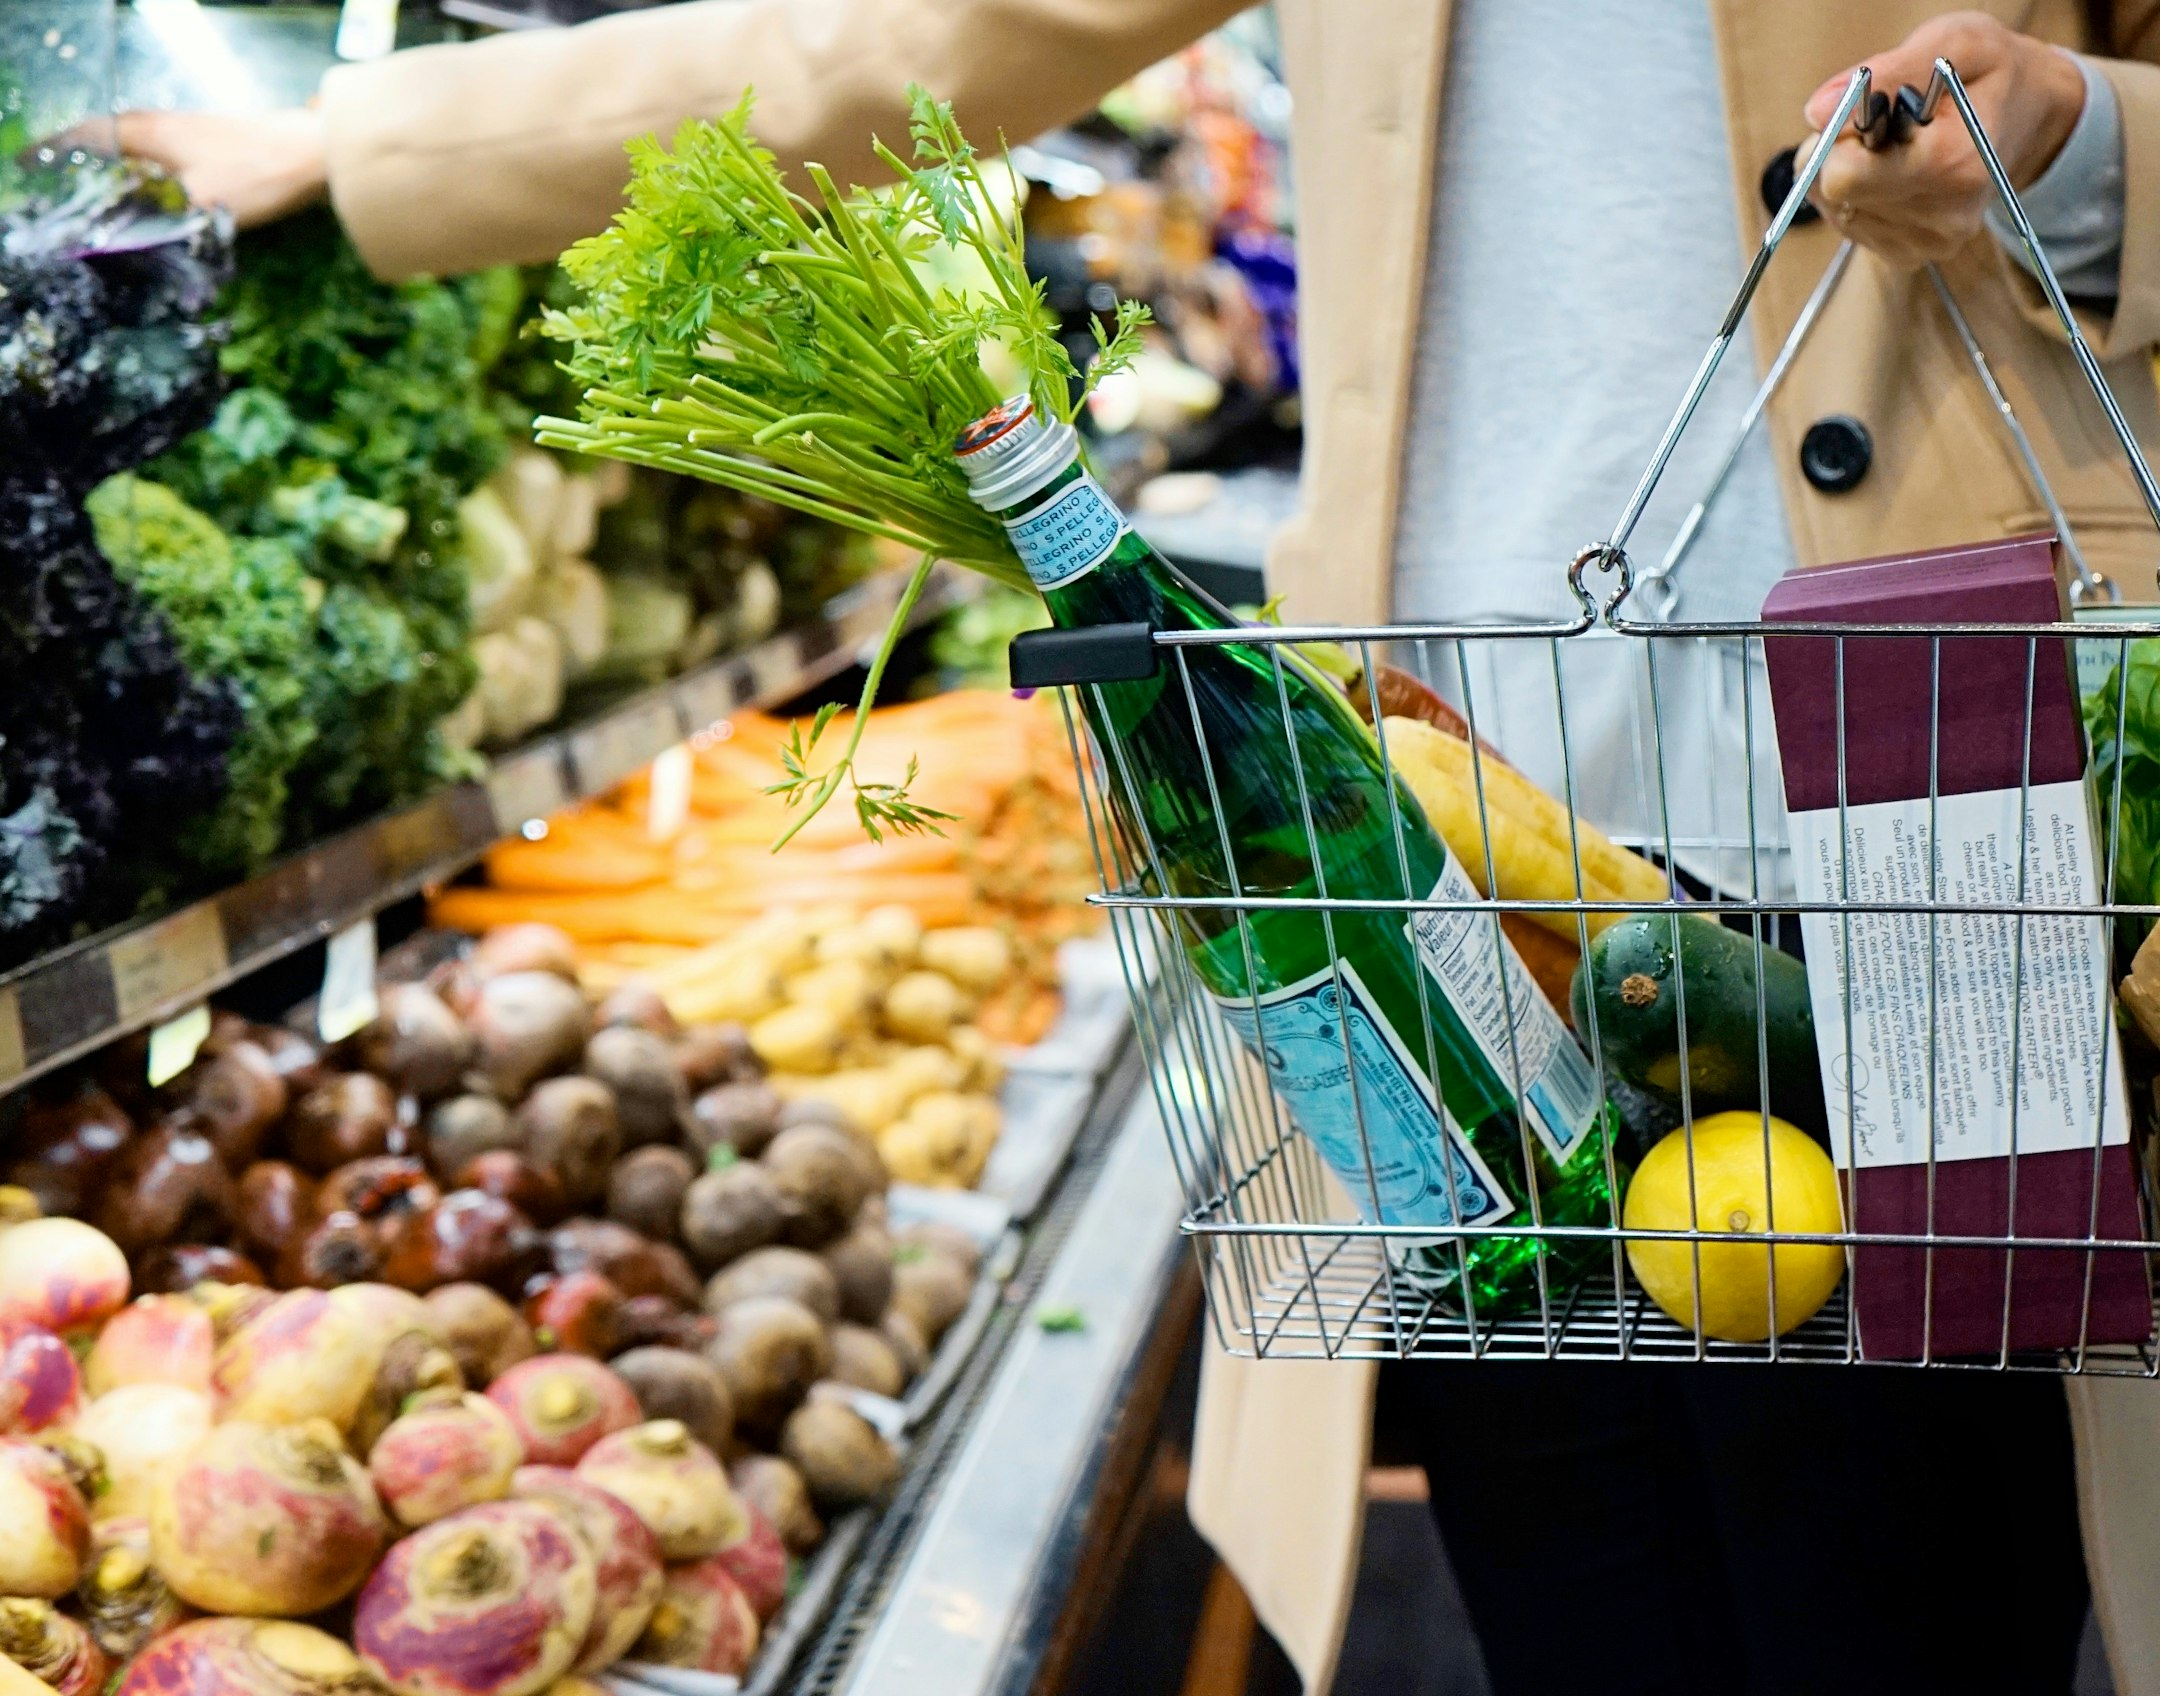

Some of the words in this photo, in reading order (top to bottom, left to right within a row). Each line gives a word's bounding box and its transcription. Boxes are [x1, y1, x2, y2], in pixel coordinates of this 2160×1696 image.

[1936, 876, 1950, 903] Stow
[1955, 880, 1966, 904] snac
[2003, 873, 2017, 902] CRIS
[2023, 895, 2035, 919] frm
[2047, 892, 2059, 920] mae
[2060, 891, 2073, 923] The
[1916, 912, 1928, 940] etites
[1996, 912, 2009, 948] ackers
